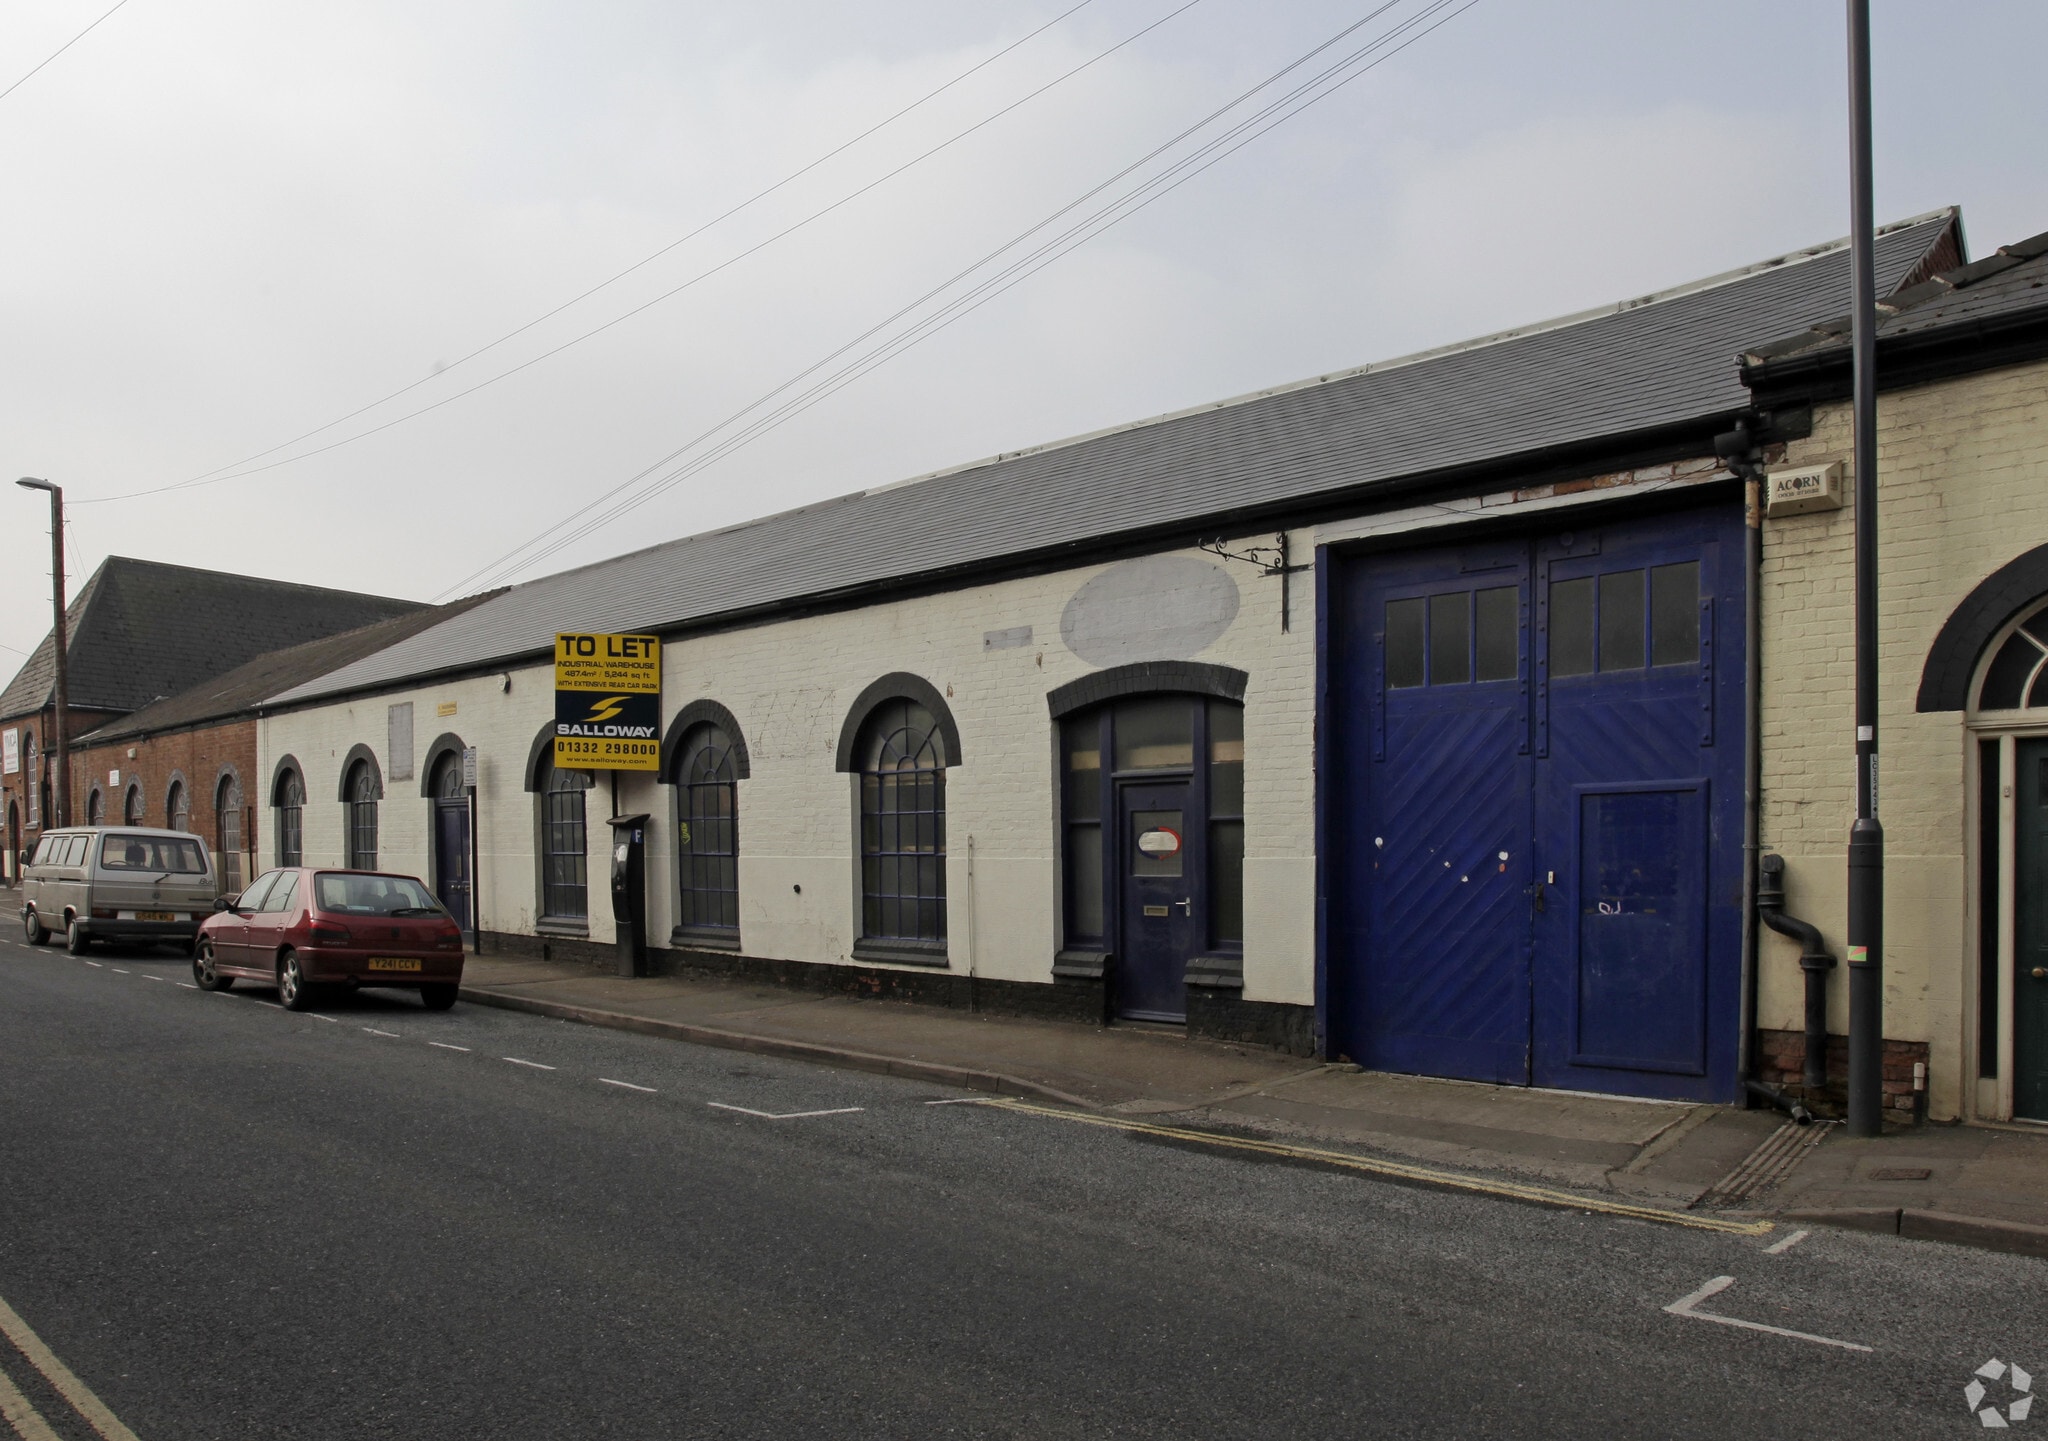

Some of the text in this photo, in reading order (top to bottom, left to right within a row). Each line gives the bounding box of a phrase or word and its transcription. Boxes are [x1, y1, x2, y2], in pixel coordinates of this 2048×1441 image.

[1777, 475, 1820, 491] ACORN
[561, 636, 655, 658] TO LET
[557, 724, 655, 737] SALLOWAY
[558, 742, 656, 754] 01332 298000
[375, 959, 416, 968] Y241 CCV
